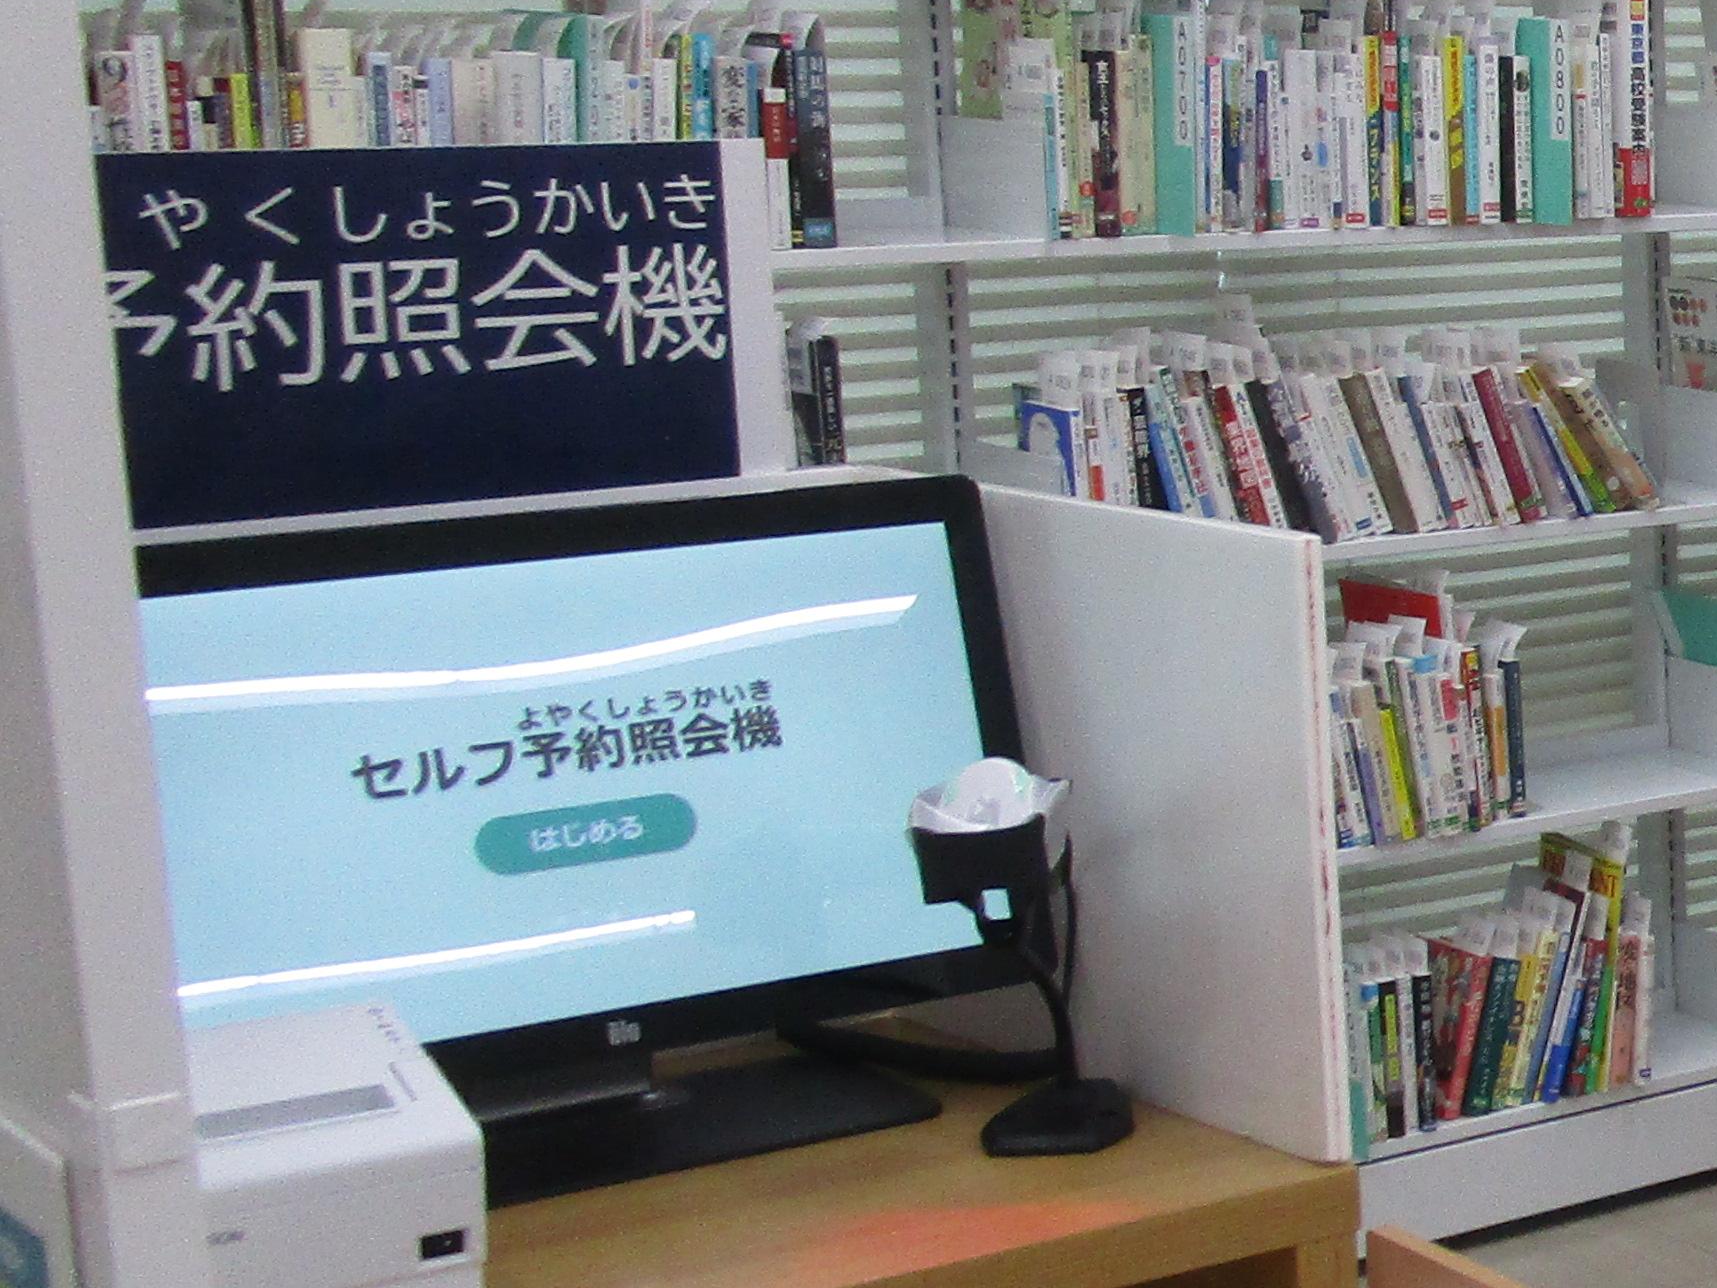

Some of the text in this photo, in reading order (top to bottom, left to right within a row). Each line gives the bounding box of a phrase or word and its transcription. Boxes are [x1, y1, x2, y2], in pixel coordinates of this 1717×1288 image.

[1177, 21, 1189, 141] A0700
[1553, 24, 1566, 135] A0800
[138, 172, 719, 252] やくしょうかいき
[516, 678, 772, 731] よやくしょうかいき
[351, 704, 784, 801] セルフ予約照会機
[528, 813, 645, 853] はじめる
